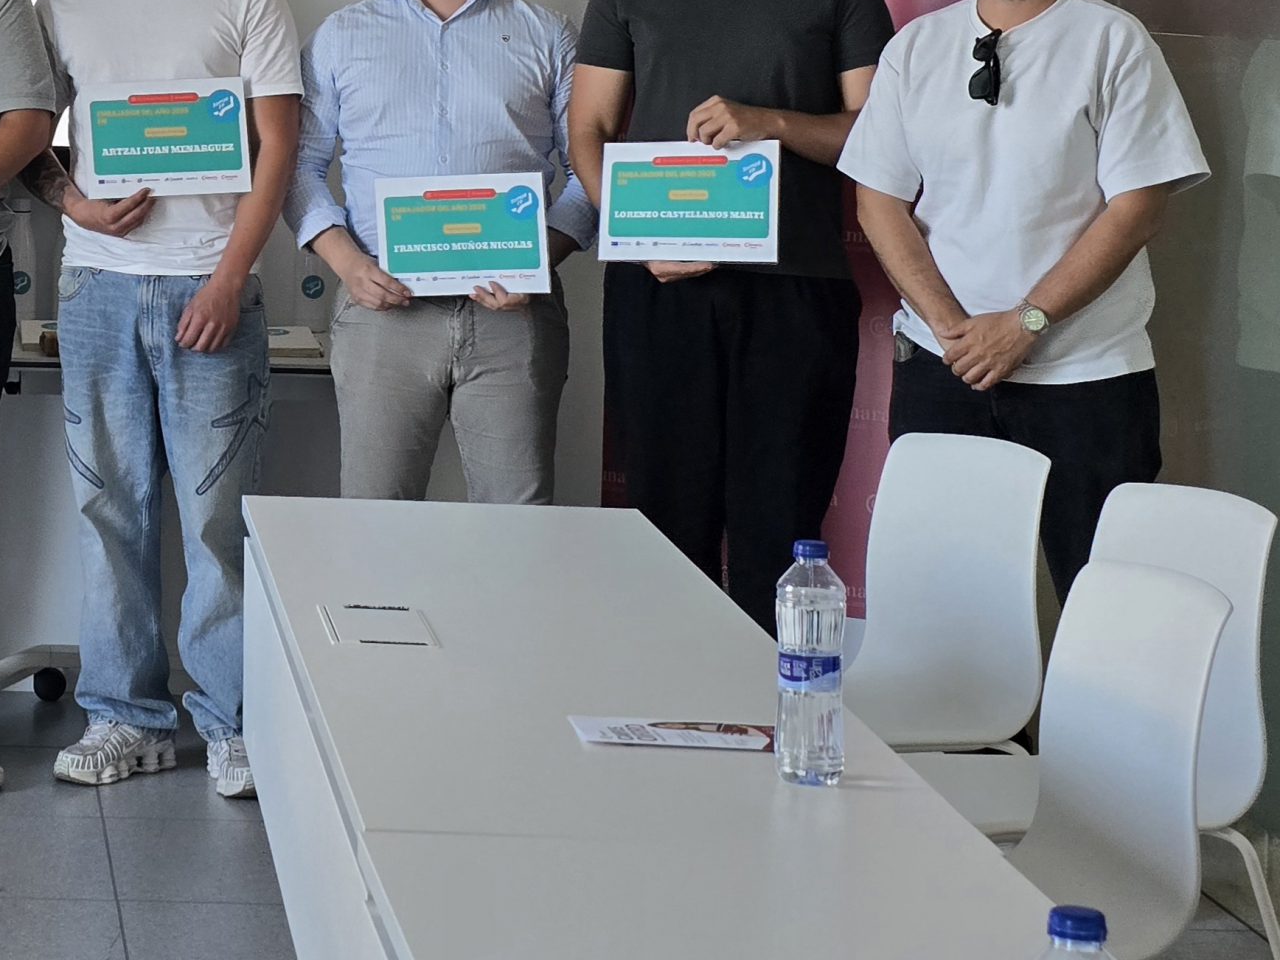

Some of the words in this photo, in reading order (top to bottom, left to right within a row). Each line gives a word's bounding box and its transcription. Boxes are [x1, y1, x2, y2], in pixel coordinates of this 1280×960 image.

[142, 145, 169, 155] JUAN
[394, 242, 450, 253] FRANCISCO
[452, 240, 489, 251] MUÑOZ
